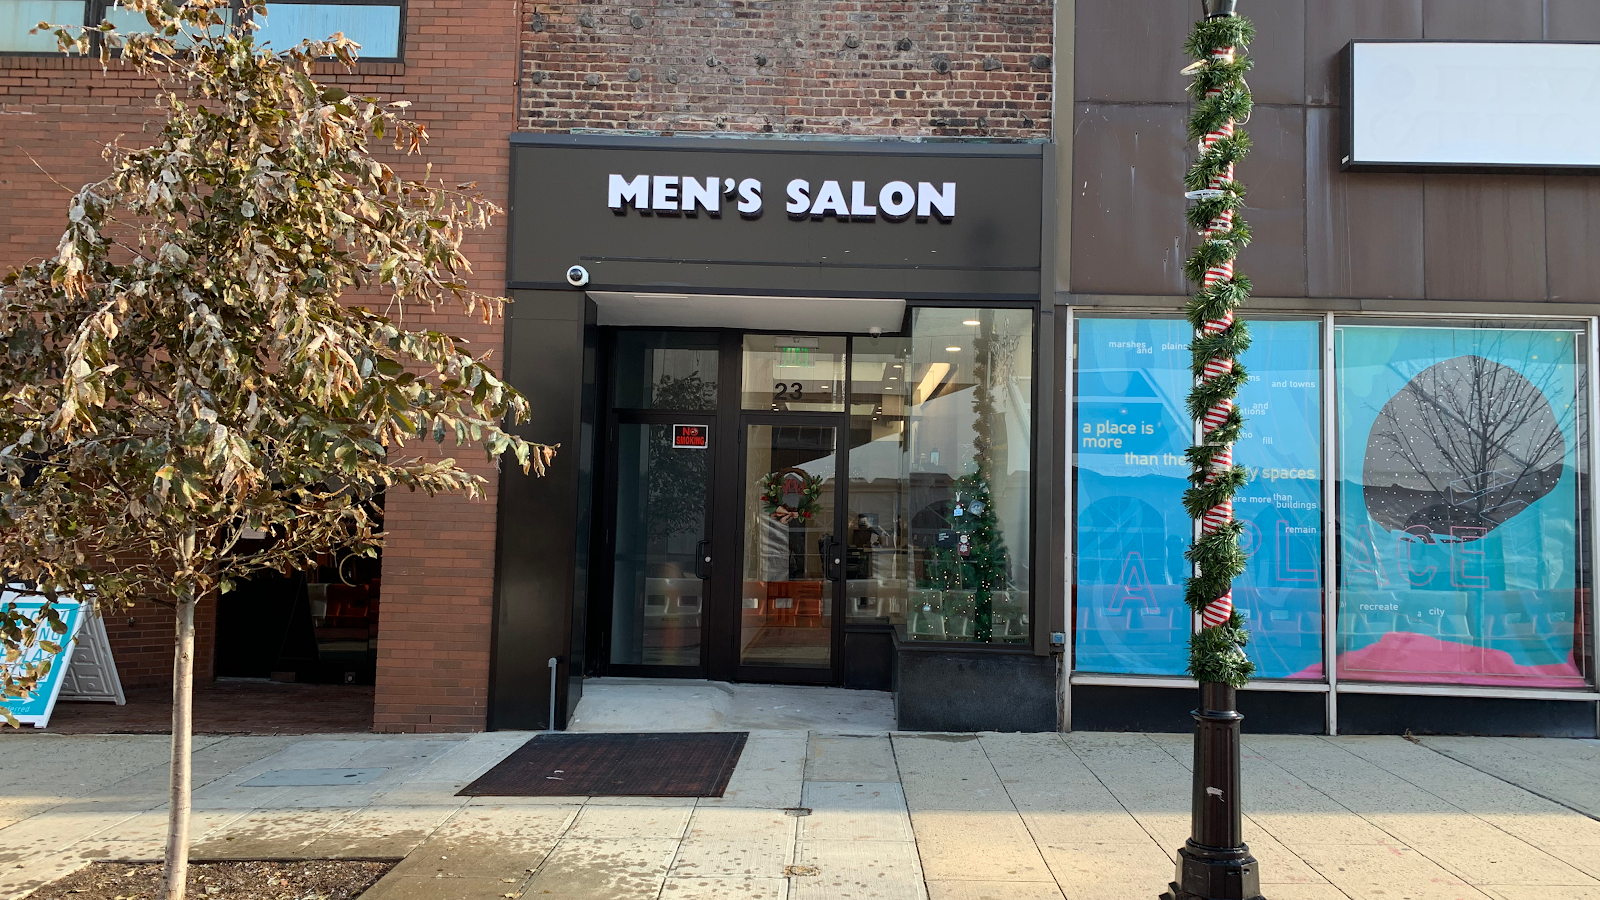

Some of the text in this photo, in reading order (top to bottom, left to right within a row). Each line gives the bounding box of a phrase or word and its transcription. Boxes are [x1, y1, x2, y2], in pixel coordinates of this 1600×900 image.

[608, 174, 956, 218] MEN'S SALON
[1108, 340, 1188, 354] marshes and plains
[1271, 380, 1288, 388] and
[1289, 380, 1316, 388] towns
[774, 382, 803, 400] 23
[1252, 401, 1269, 410] and
[682, 426, 699, 437] NO
[1082, 420, 1155, 437] a place is
[676, 436, 705, 446] SMOKING
[1082, 437, 1123, 449] more
[1262, 436, 1274, 445] fill
[1124, 451, 1187, 467] than the
[1262, 467, 1316, 483] spaces
[1249, 496, 1272, 504] more
[1273, 492, 1293, 501] than
[1276, 500, 1317, 511] buildings
[1285, 525, 1317, 534] remain
[1359, 602, 1399, 611] recreate
[1428, 607, 1445, 618] city
